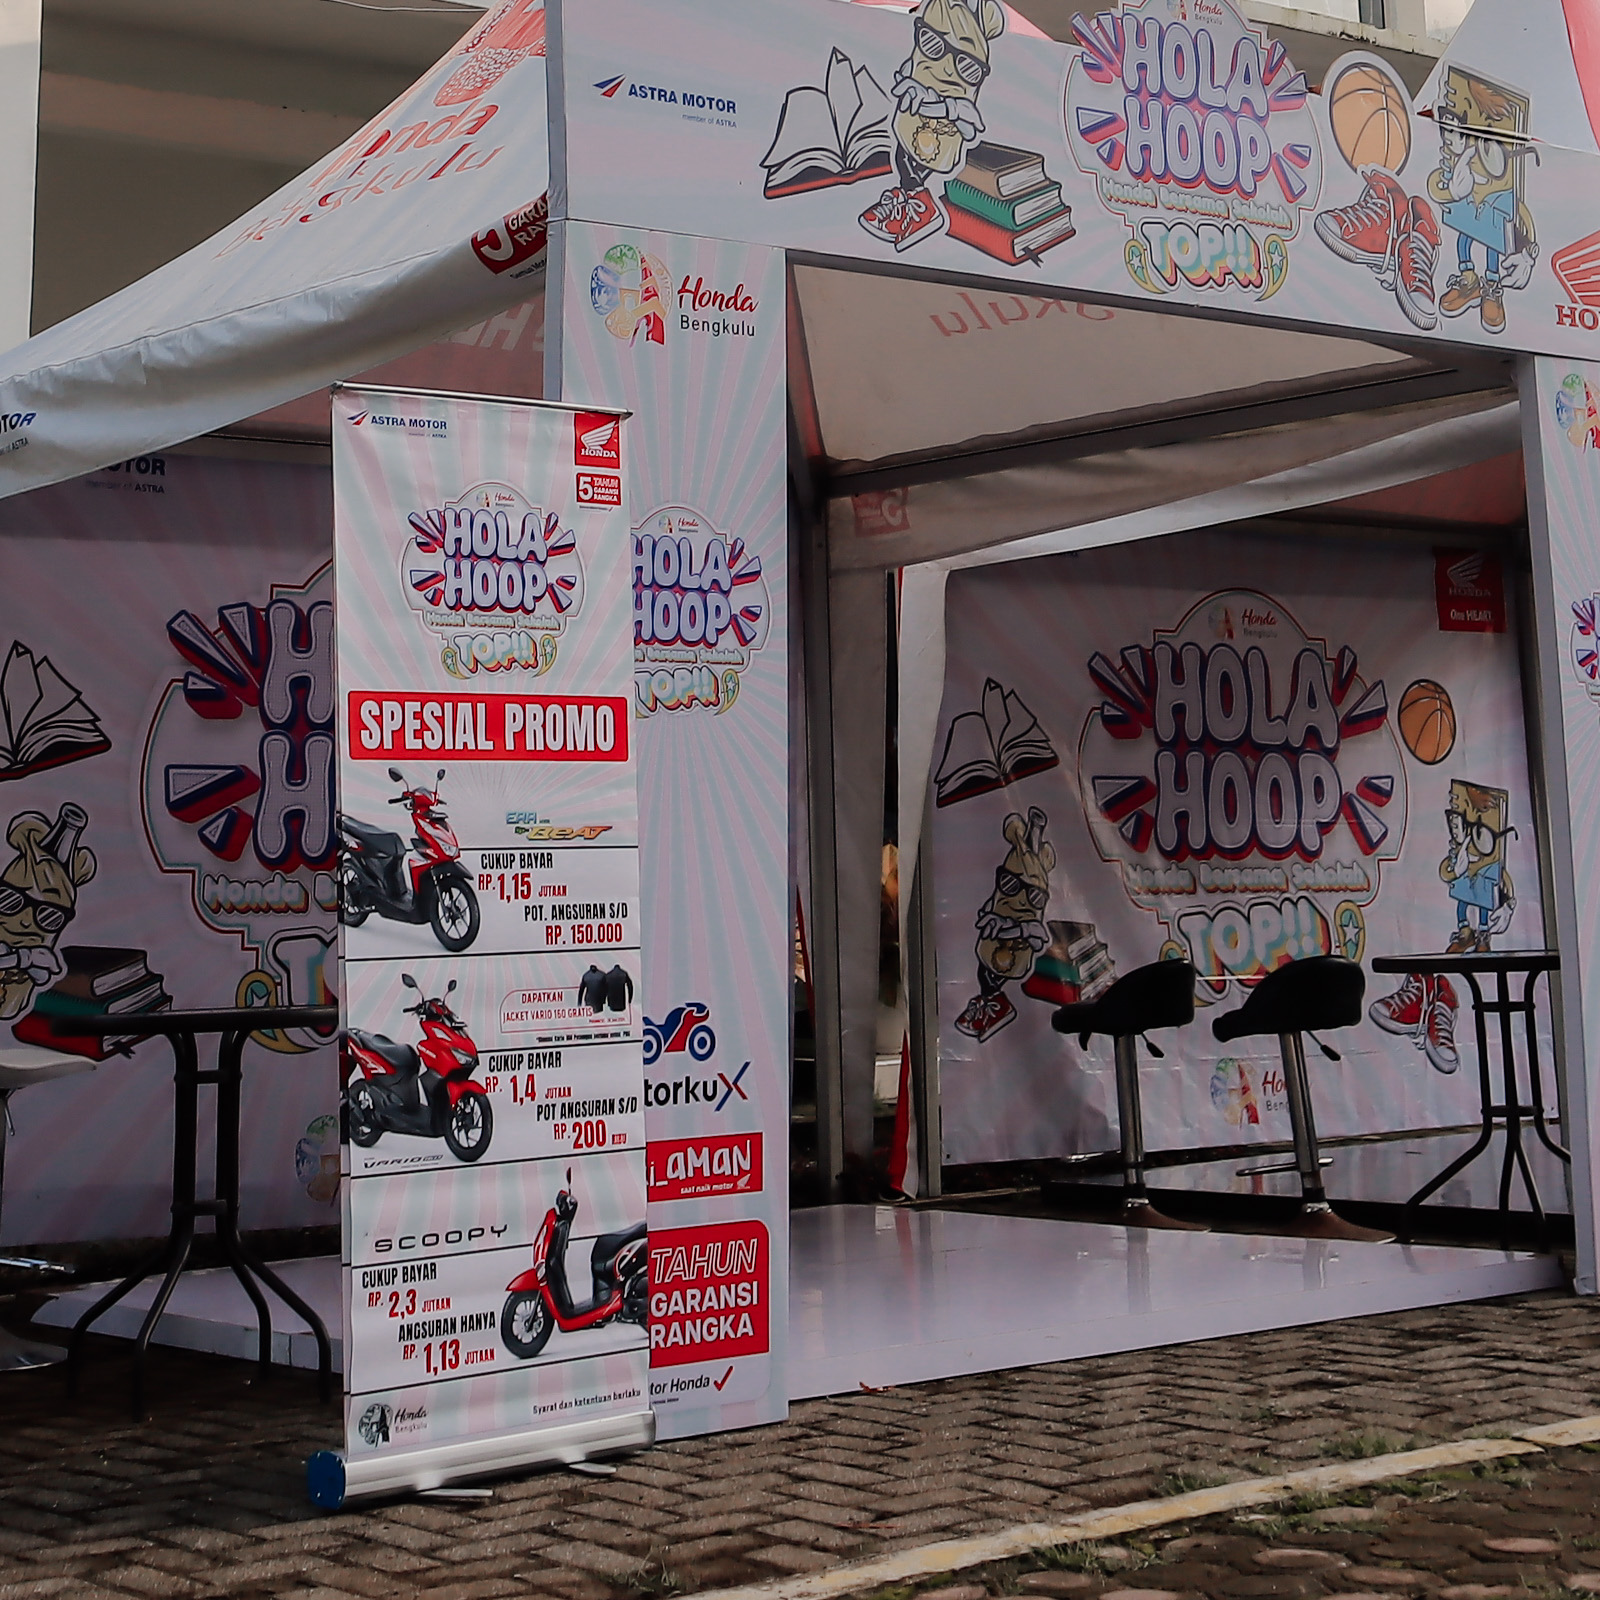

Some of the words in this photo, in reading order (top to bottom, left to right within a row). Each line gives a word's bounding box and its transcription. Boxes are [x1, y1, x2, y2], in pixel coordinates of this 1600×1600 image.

[1122, 13, 1268, 119] HOLA
[628, 83, 678, 104] ASTRA
[682, 92, 737, 114] MOTOR
[715, 118, 737, 128] ASTRA
[1124, 95, 1272, 194] HOOP
[1141, 223, 1263, 287] TOP!!
[677, 275, 759, 312] Honda
[680, 315, 755, 337] Bengkulu
[371, 416, 406, 427] ASTRA
[408, 418, 447, 430] MOTOR
[581, 448, 617, 460] HONDA
[135, 483, 165, 494] ASTRA
[579, 476, 593, 501] 5
[443, 507, 548, 564] HOLA
[444, 557, 548, 614] HOOP
[1242, 608, 1278, 628] Honda
[454, 631, 538, 673] TOP!!
[1153, 641, 1340, 752] HOLA
[361, 699, 494, 752] SPESIAL
[505, 702, 615, 752] PROMO
[1155, 747, 1343, 862] HOOP
[481, 853, 515, 870] CUKUP
[520, 852, 553, 869] BAYAR
[203, 872, 309, 914] Honda
[478, 874, 496, 891] RP.
[498, 872, 532, 903] 1,15
[538, 885, 567, 897] JUTAAN
[524, 905, 548, 922] POT.
[551, 903, 606, 921] ANGSURAN
[609, 902, 628, 919] S/D
[545, 925, 566, 945] RP.
[571, 923, 623, 944] 150.000
[521, 991, 563, 1004] DAPATKAN
[503, 1010, 529, 1024] JACKET
[530, 1009, 553, 1020] VARIO
[568, 1007, 593, 1018] GRATIS
[489, 1053, 524, 1072] CUKUP
[527, 1051, 562, 1069] BAYAR
[485, 1076, 502, 1093] RP.
[510, 1074, 536, 1106] 1,4
[545, 1087, 571, 1099] JUTAAN
[644, 1061, 751, 1112] torkuX
[537, 1104, 556, 1121] POT
[560, 1099, 615, 1119] ANGSURAN
[618, 1097, 637, 1114] S/D
[554, 1123, 570, 1140] RP.
[572, 1120, 606, 1149] 200
[375, 1224, 507, 1253] SCOOPY
[362, 1267, 398, 1289] CUKUP
[402, 1262, 437, 1284] BAYAR
[651, 1238, 758, 1284] TAHUN
[368, 1292, 384, 1308] RP.
[389, 1289, 417, 1319] 2,3
[422, 1297, 451, 1313] JUTAAN
[650, 1281, 758, 1318] GARANSI
[398, 1317, 457, 1343] ANGSURAN
[461, 1311, 496, 1332] HANYA
[650, 1312, 754, 1350] RANGKA
[403, 1344, 418, 1360] RP.
[424, 1339, 460, 1375] 1,13
[465, 1348, 495, 1365] JUTAAN
[670, 1375, 711, 1394] Honda
[395, 1407, 428, 1423] Honda
[533, 1403, 557, 1415] Syarat
[559, 1400, 573, 1410] dan
[574, 1394, 611, 1407] ketentuan
[613, 1388, 641, 1400] berlaku
